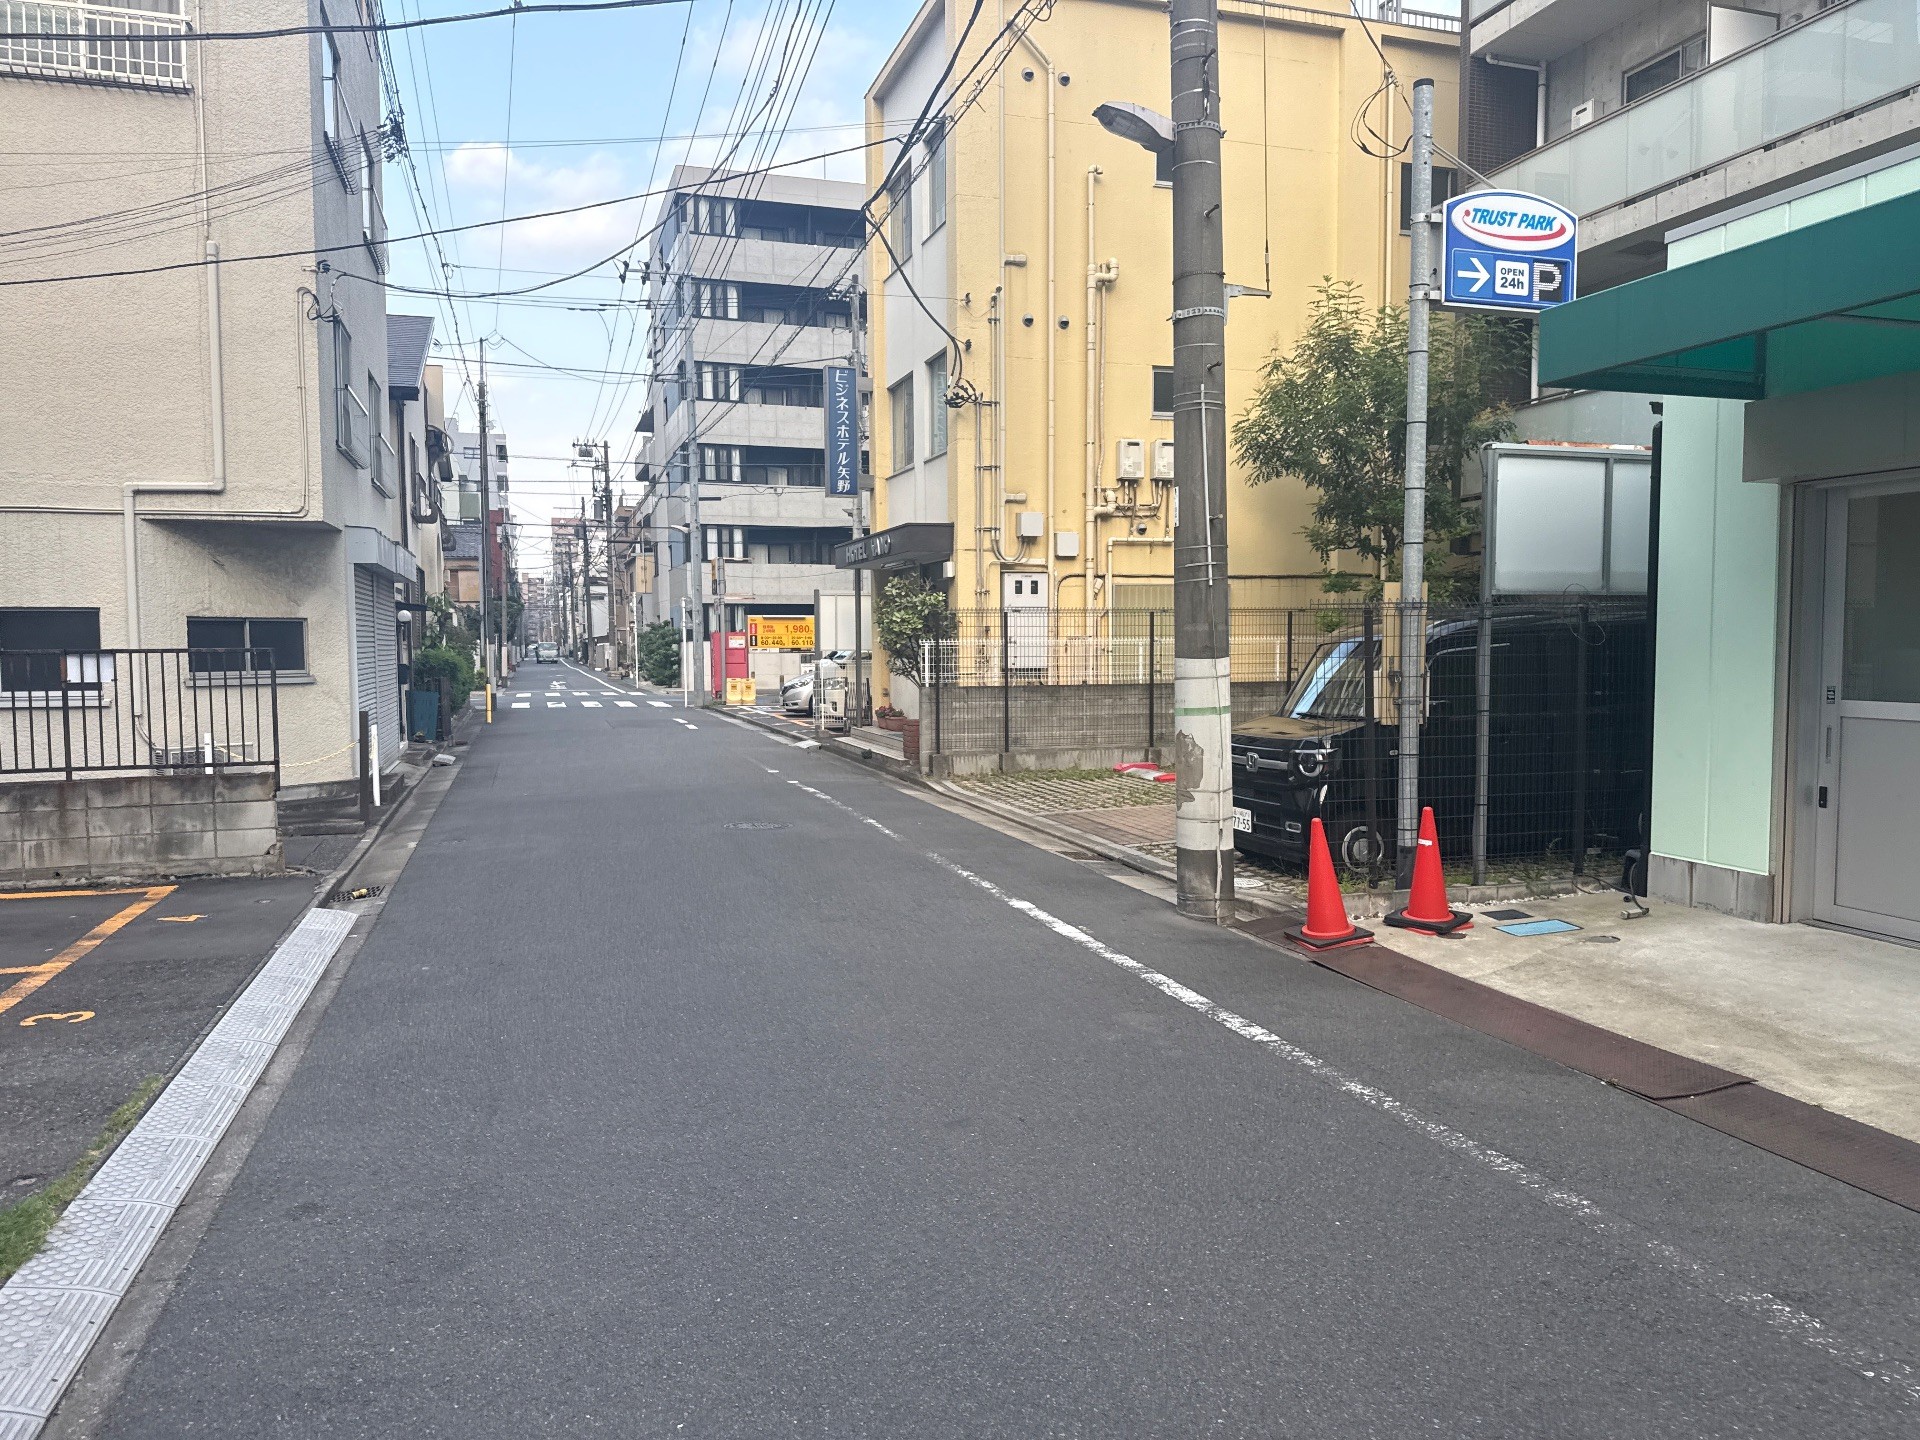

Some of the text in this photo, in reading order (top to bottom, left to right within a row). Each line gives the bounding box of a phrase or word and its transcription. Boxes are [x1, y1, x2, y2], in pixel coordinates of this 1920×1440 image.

[1471, 208, 1557, 231] TRUST PARK
[1500, 267, 1525, 277] OPEN
[1532, 262, 1562, 301] P
[1500, 277, 1525, 290] 24h
[835, 369, 851, 493] ビジネスホテル矢野
[845, 541, 866, 562] HOTEL
[19, 1010, 96, 1027] 3
